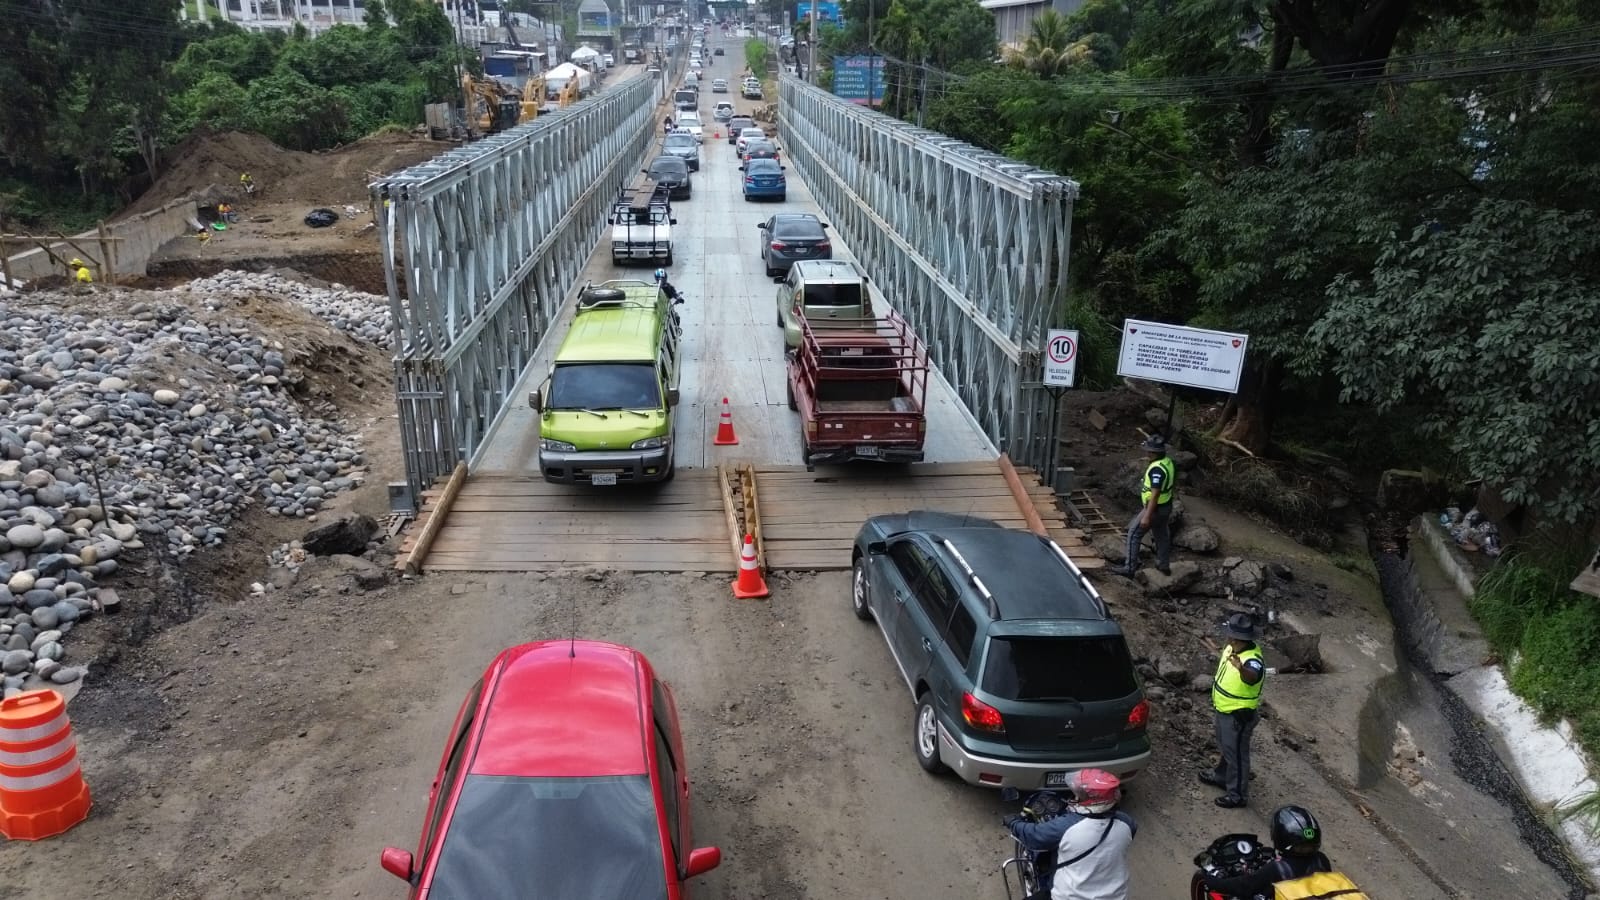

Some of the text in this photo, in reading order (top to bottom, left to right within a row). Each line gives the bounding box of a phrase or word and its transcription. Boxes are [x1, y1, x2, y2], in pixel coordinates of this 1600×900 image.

[1053, 340, 1070, 355] 10
[1138, 343, 1168, 351] CAPACIDAD
[1176, 348, 1207, 356] TONELADAS
[1136, 353, 1168, 361] CONSTANTE
[1138, 348, 1166, 356] MANTENER
[1179, 353, 1209, 361] VELOCIDAD
[1201, 366, 1231, 374] VELOCIDAD
